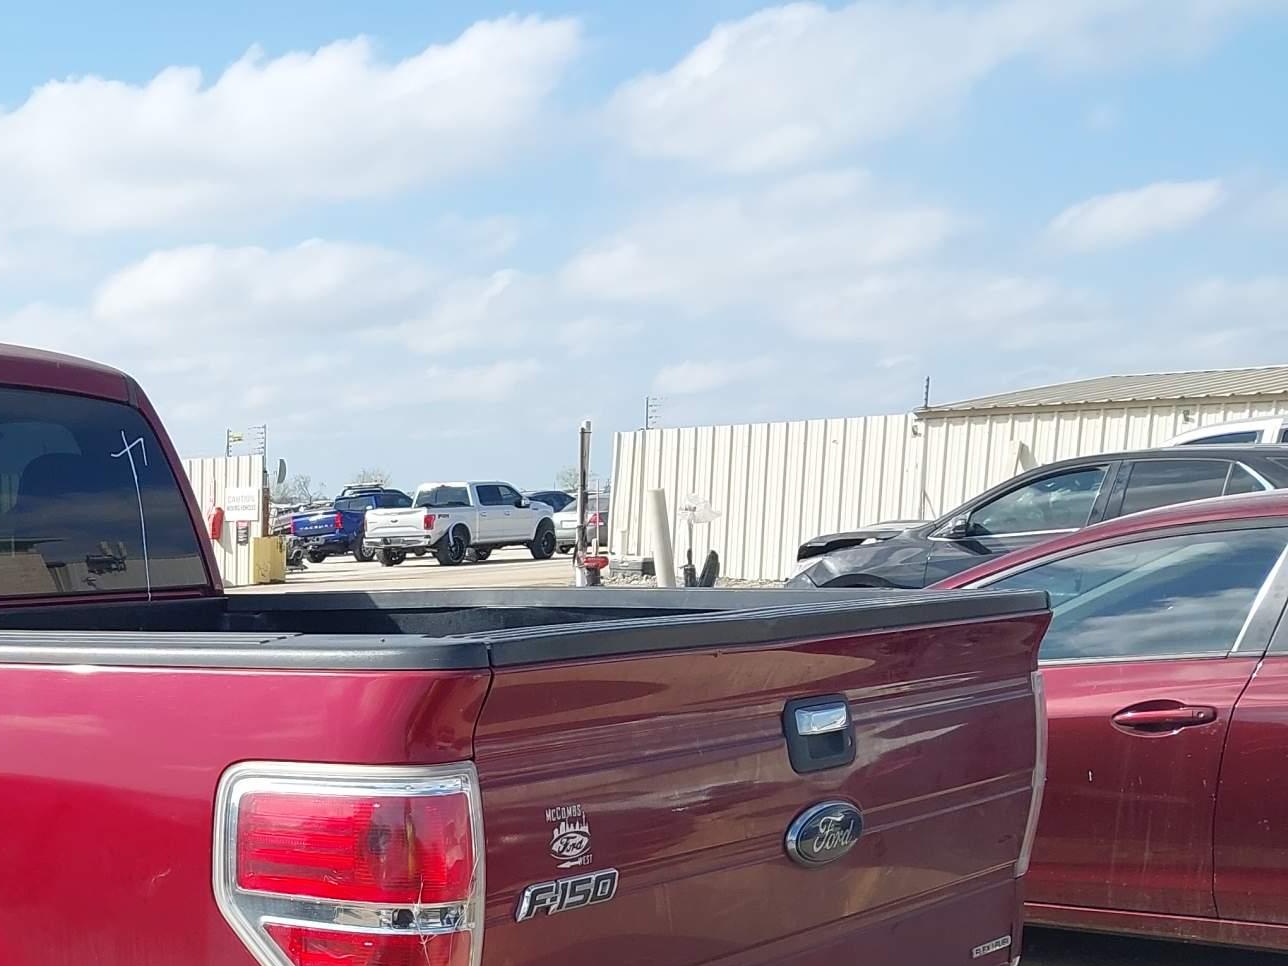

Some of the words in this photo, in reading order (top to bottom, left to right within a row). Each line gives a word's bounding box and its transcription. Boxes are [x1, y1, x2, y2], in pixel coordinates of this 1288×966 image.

[558, 835, 584, 854] Ford
[813, 813, 858, 853] Ford
[578, 854, 593, 866] WEST
[516, 868, 619, 923] F-150
